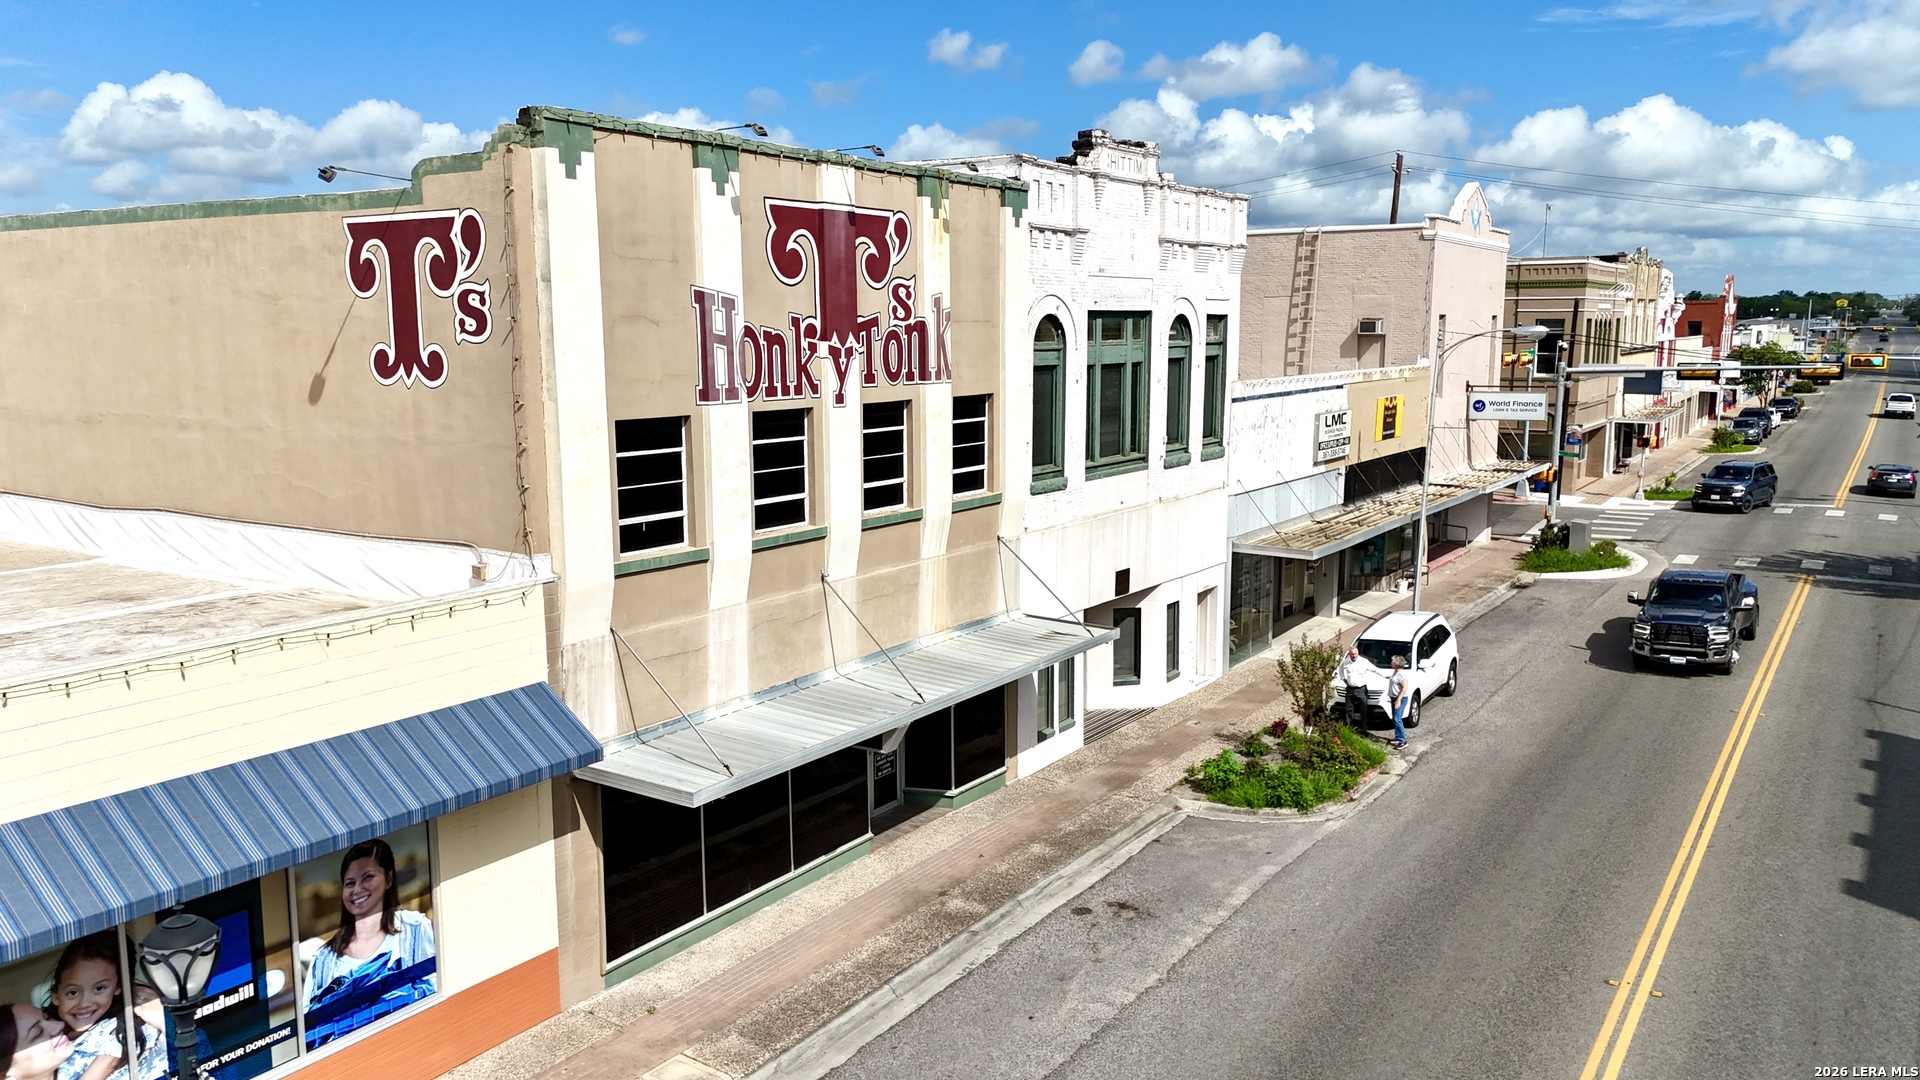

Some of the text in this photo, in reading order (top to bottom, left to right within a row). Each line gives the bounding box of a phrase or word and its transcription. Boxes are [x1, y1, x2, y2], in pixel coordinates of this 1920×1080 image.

[342, 207, 493, 389] T's
[764, 197, 916, 345] T's
[690, 285, 951, 408] Honky Tonk
[1325, 412, 1347, 428] LMC
[194, 983, 255, 1020] oodwill
[220, 1047, 245, 1062] YOUR
[246, 1027, 291, 1053] DONATION!
